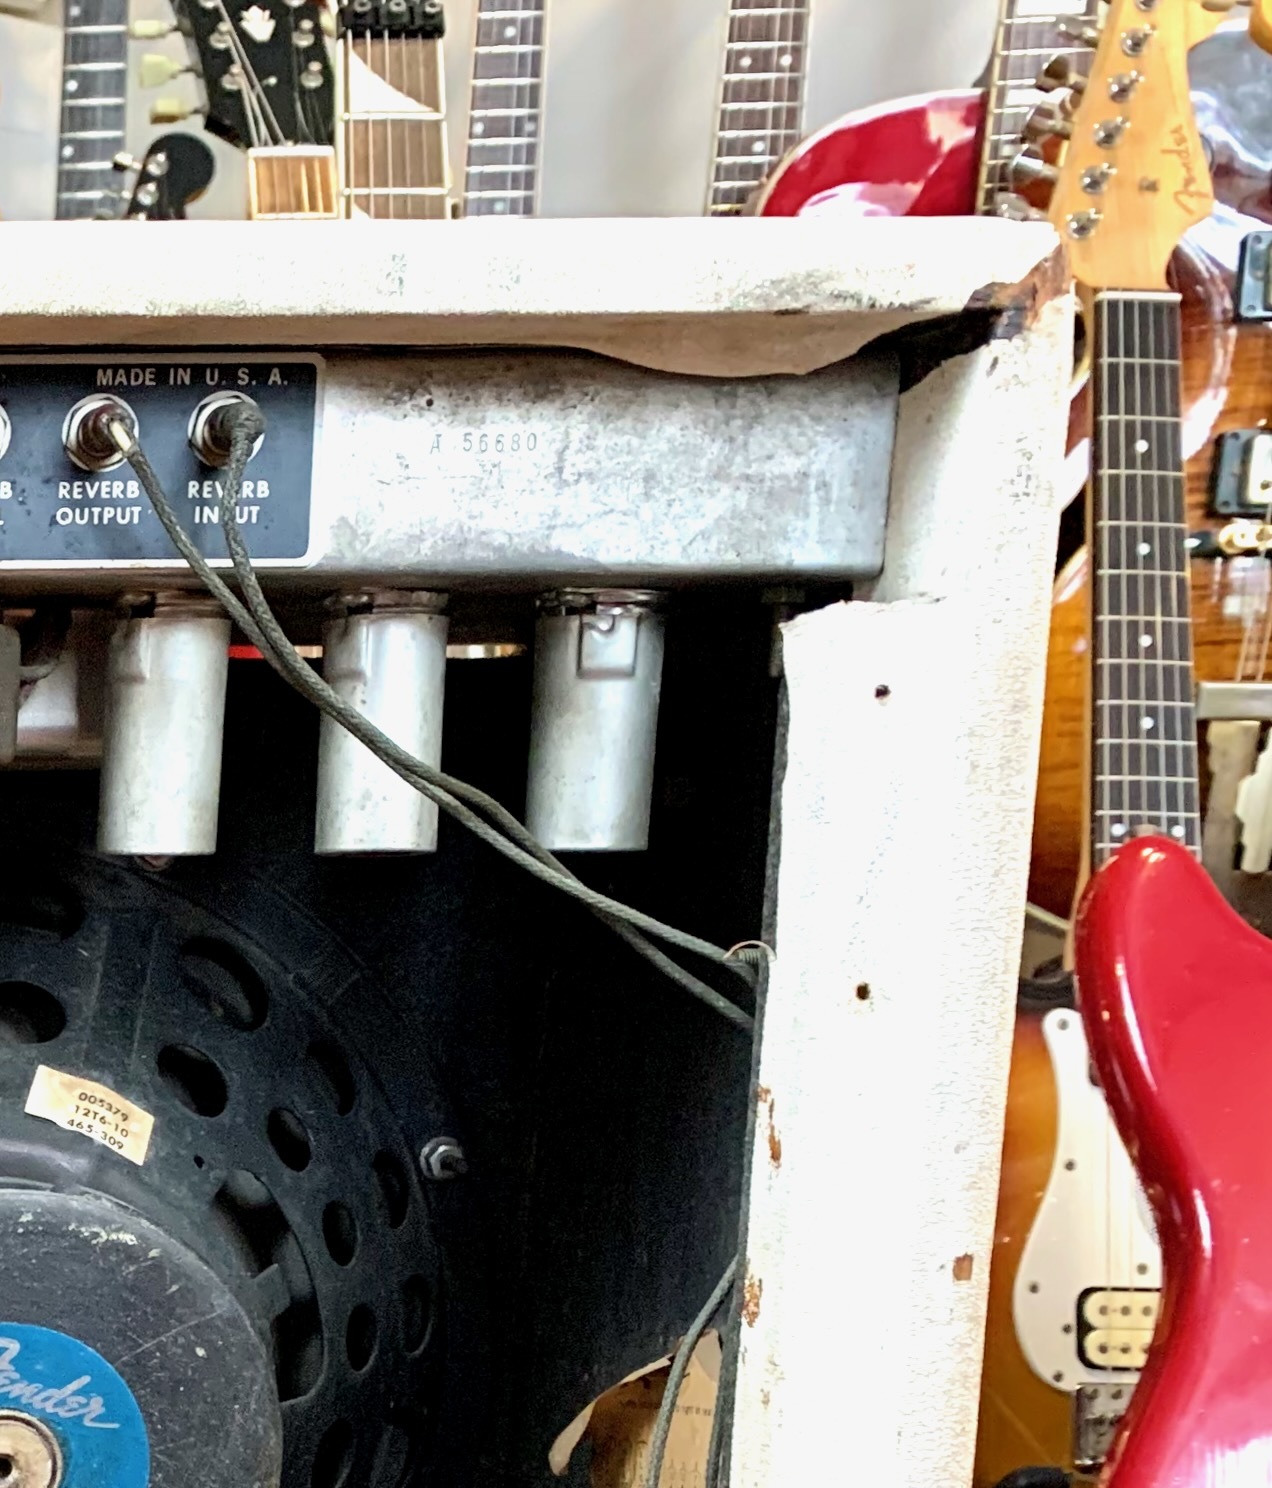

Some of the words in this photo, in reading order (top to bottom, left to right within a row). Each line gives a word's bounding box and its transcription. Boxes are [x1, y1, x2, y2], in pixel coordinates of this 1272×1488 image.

[96, 367, 156, 386] MADE
[169, 367, 191, 385] IN
[462, 431, 537, 453] 56680
[58, 480, 140, 499] REVERB
[187, 480, 270, 499] REVRB
[56, 505, 143, 526] OUTPUT
[194, 505, 261, 524] INUT
[74, 1104, 129, 1139] 12T6-10
[67, 1118, 124, 1150] 465-309
